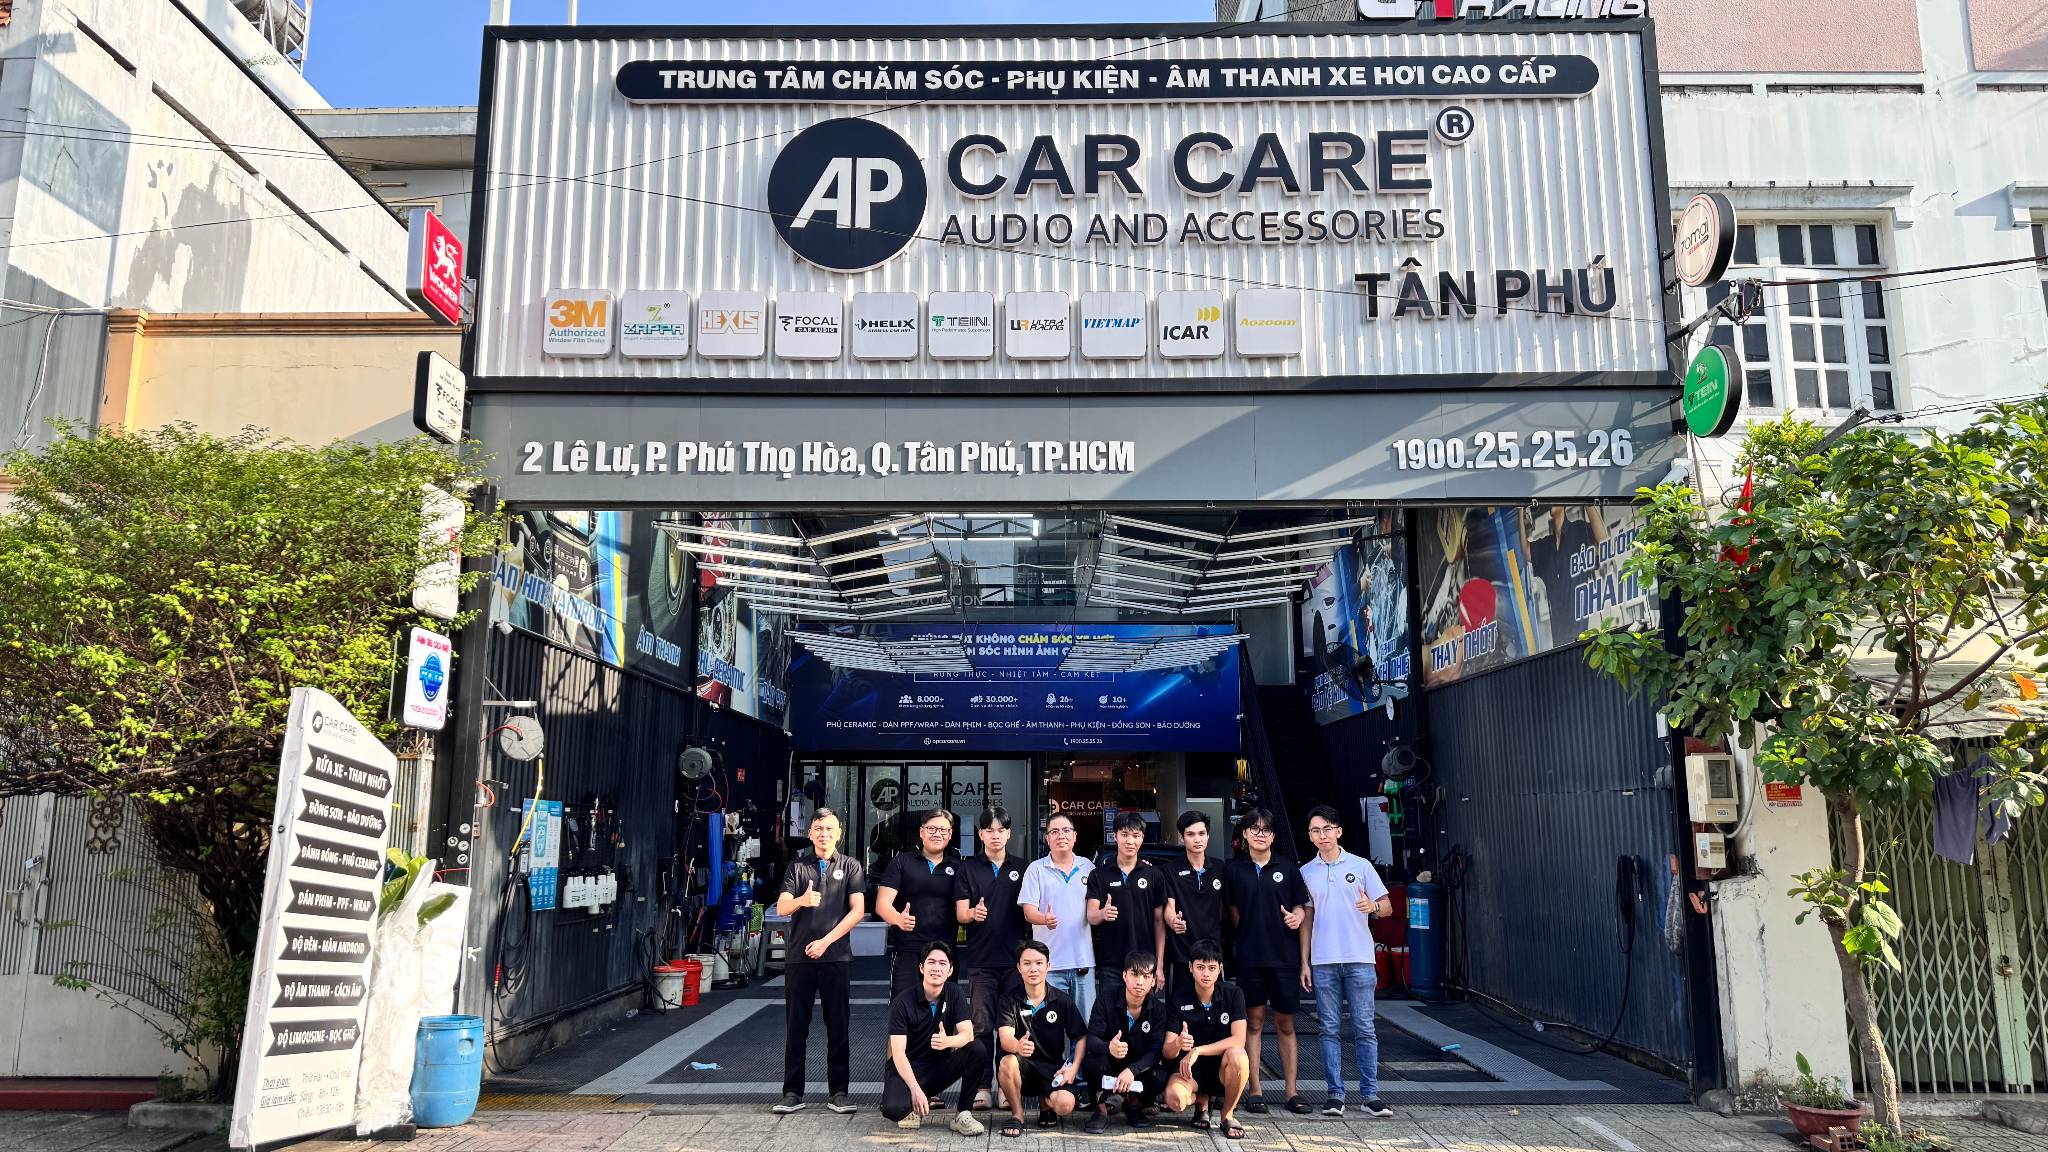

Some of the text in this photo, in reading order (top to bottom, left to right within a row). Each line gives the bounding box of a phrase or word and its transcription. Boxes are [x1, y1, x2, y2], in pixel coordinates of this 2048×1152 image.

[659, 56, 1557, 95] TRUNG TÂM CHĂM SÓC PHỤ KIỆN ÂM THANH XE HƠI CAO CẤP
[947, 133, 1143, 199] CAR
[1173, 129, 1433, 197] CARE
[790, 156, 903, 230] AP
[940, 207, 1446, 248] AUDIO AND ACCESSORIES
[429, 264, 458, 305] WOLVER
[1354, 254, 1617, 320] TÂN PHÚ
[549, 299, 607, 328] 3M
[795, 315, 838, 327] FOCAL
[701, 309, 760, 335] HEXIS
[868, 318, 916, 329] HELIX
[1084, 318, 1141, 330] VIETMAP
[1239, 318, 1297, 327] Aozoom
[549, 328, 606, 337] Authorized
[1163, 325, 1210, 341] ICAR
[1392, 428, 1634, 470] 1900.25.25.26
[522, 439, 1136, 479] 2 Lê Lư, P. Phú Thọ Hòa, Q. Tân Phú, TP.HCM
[1570, 543, 1596, 578] BẢO
[975, 632, 1015, 644] KHÔNG
[1018, 632, 1048, 644] CHĂM
[978, 644, 1000, 655] SÓC
[1004, 644, 1033, 655] HÌNH
[1036, 644, 1058, 655] ẢNH
[1431, 636, 1459, 674] THAY
[917, 695, 944, 703] 8.000+
[986, 695, 1018, 703] 30.000+
[1113, 695, 1127, 703] 10+
[324, 716, 339, 729] CAR
[843, 721, 877, 729] CERAMIC
[900, 721, 940, 729] PPF/WRAP
[1038, 721, 1064, 729] THANH
[316, 753, 388, 791] RỬA XE THAY NHỚT
[875, 786, 898, 803] AP
[950, 782, 1002, 796] CARE
[1061, 801, 1085, 810] CAR
[329, 806, 344, 821] SƠN
[347, 808, 360, 825] BẢO
[337, 896, 350, 910] PPF
[353, 898, 371, 912] WRAP
[337, 941, 365, 954] ANDROID
[284, 981, 295, 1000] ĐỘ
[295, 981, 308, 997] ÂM
[308, 984, 330, 998] THANH
[334, 981, 351, 997] CÁCH
[277, 1028, 289, 1048] ĐỘ
[289, 1030, 325, 1045] LIMOUSINE
[329, 1028, 342, 1043] BỌC
